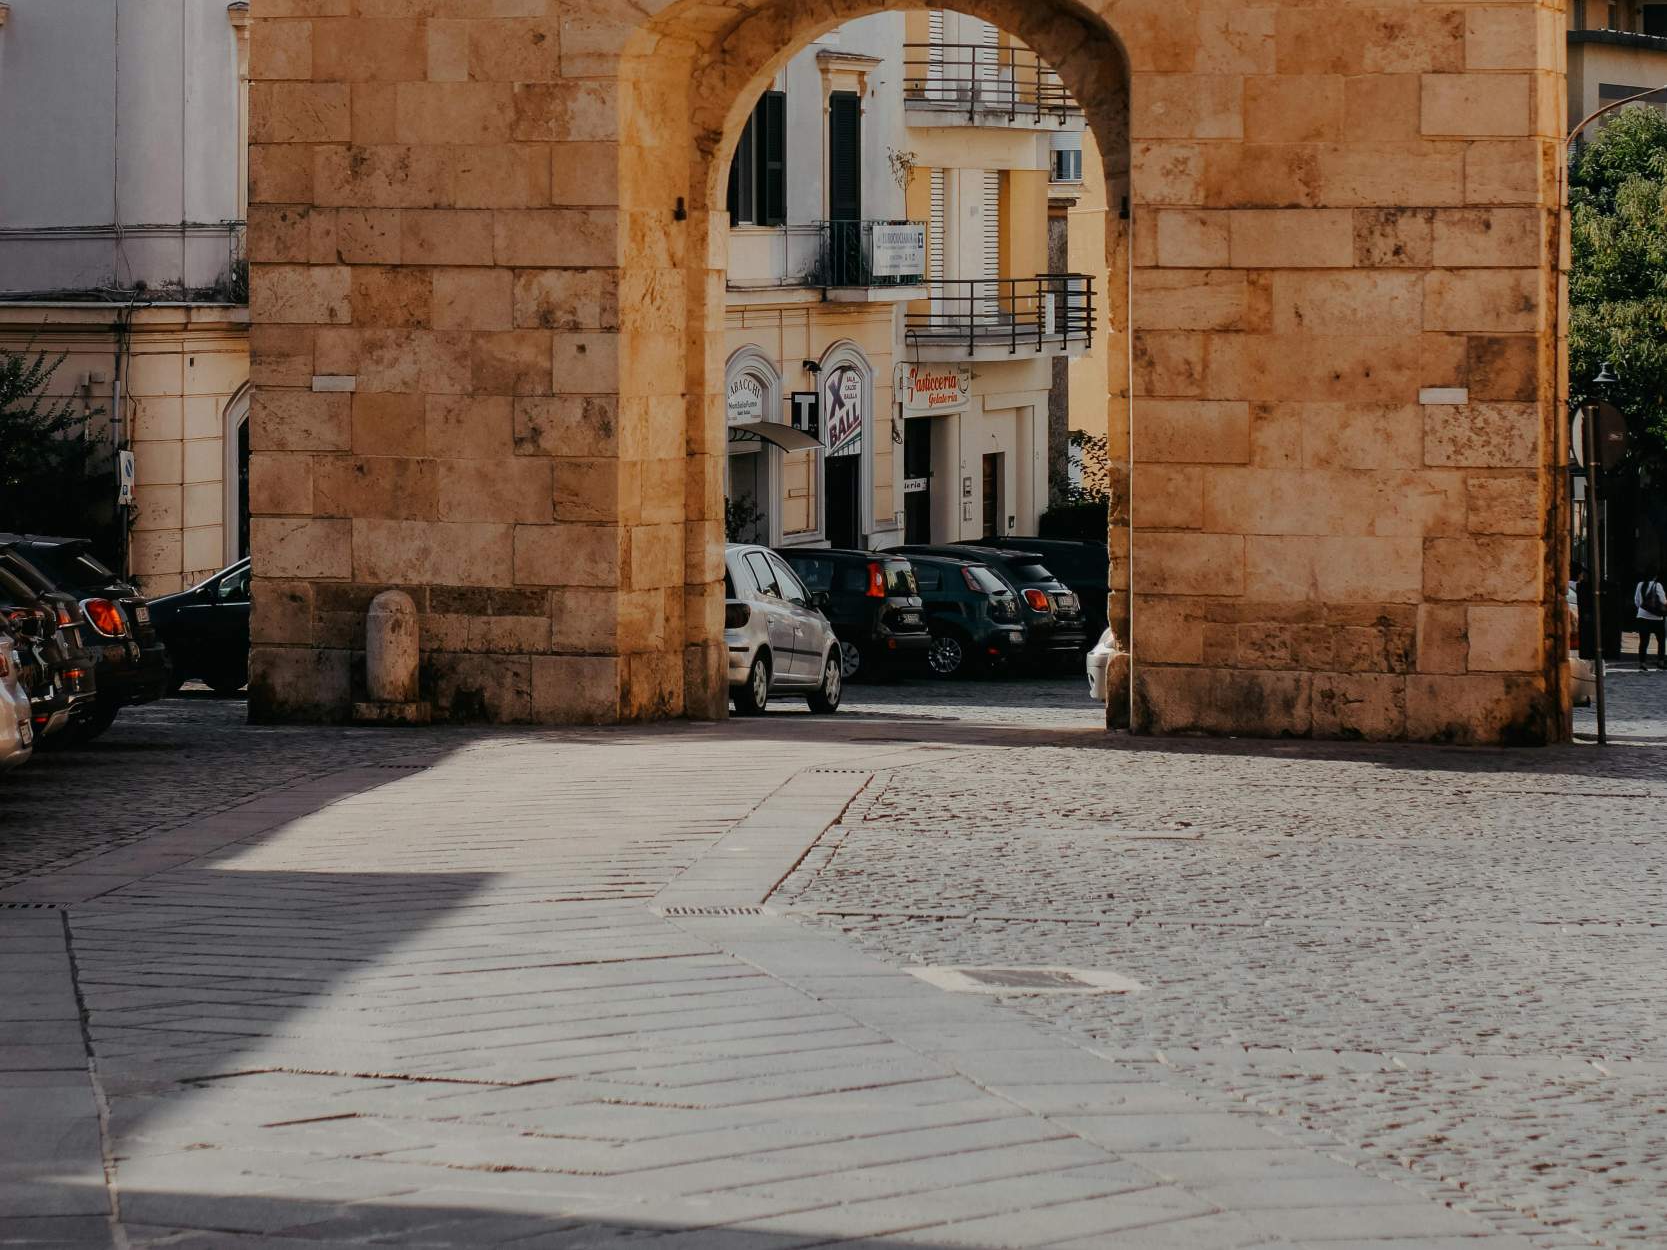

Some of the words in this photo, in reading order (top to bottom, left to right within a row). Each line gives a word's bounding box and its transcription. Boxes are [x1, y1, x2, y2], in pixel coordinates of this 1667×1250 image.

[794, 395, 815, 431] T
[828, 369, 845, 422] X
[829, 402, 859, 449] BALL
